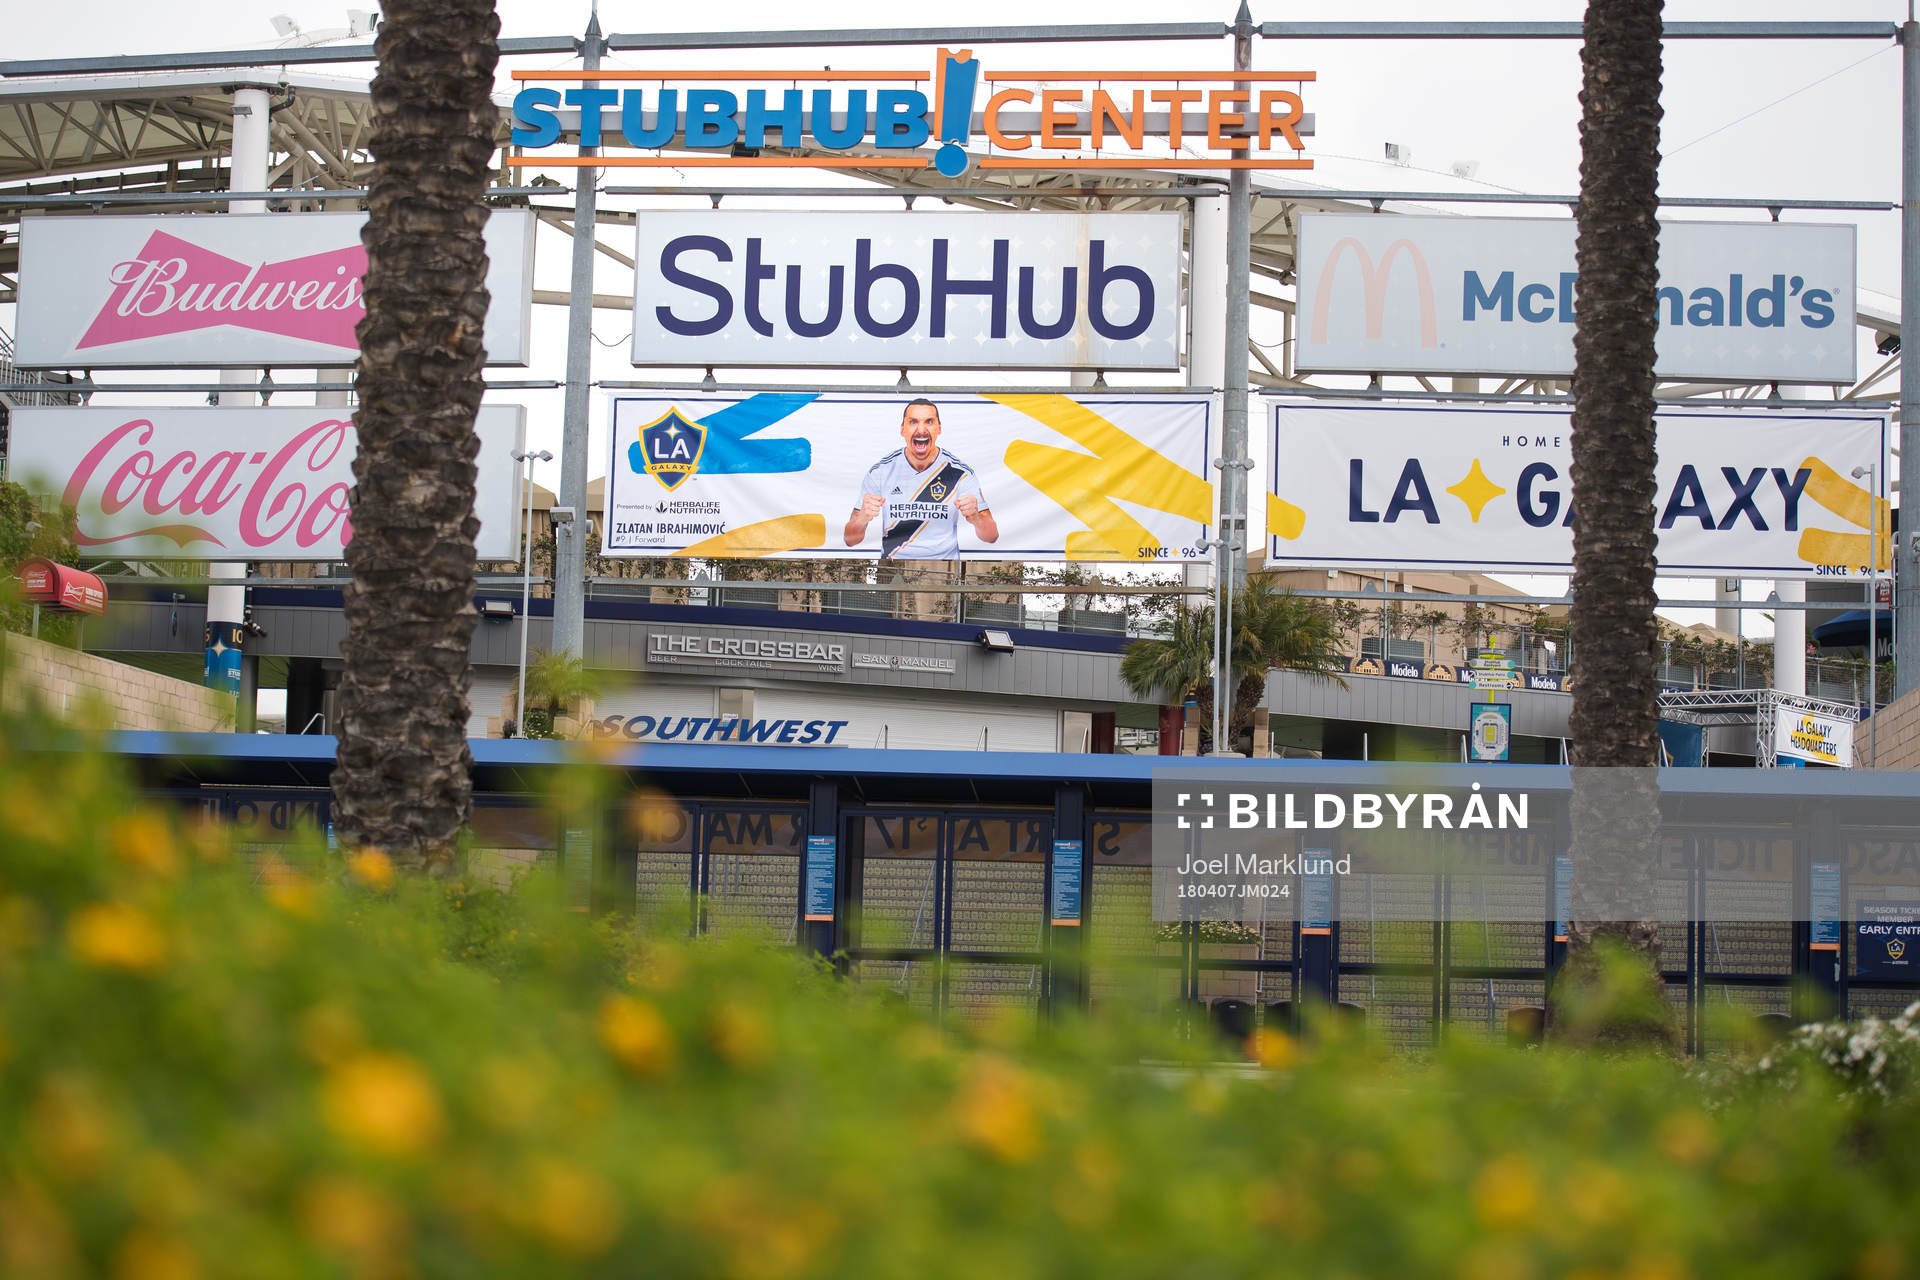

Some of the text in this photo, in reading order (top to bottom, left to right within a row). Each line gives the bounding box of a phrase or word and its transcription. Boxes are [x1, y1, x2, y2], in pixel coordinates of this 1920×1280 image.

[983, 88, 1305, 150] CENTER
[109, 256, 368, 317] Budweis
[656, 234, 1155, 341] StubHub
[1462, 270, 1836, 329] Mcnald's
[654, 437, 691, 459] LA
[1502, 435, 1561, 448] HOME
[59, 418, 354, 549] Coca-Co
[1348, 457, 1812, 532] LA GAXY
[645, 503, 653, 511] by
[889, 503, 949, 512] HERBALIFE
[889, 511, 949, 520] NUTRITION
[616, 521, 726, 535] ZLATAN IBRAHIMOVIĆ
[615, 535, 666, 544] #9 Forward
[1137, 547, 1197, 558] SINCE 96
[1815, 565, 1847, 576] SINCE
[651, 634, 845, 661] THE CROSSBAR
[650, 655, 844, 673] BEER COCKTAILS WINE
[862, 654, 951, 669] SAN MANUEL
[1391, 663, 1419, 678] Modelo
[1531, 676, 1557, 690] Modelo
[595, 714, 848, 745] SOUTHWEST
[1796, 719, 1832, 739] LA GALAXY
[1790, 734, 1837, 757] HEADQUARTERS
[1863, 906, 1898, 914] SEASON
[1877, 915, 1913, 923] MEMBER
[1859, 925, 1920, 935] EARLY ENT
